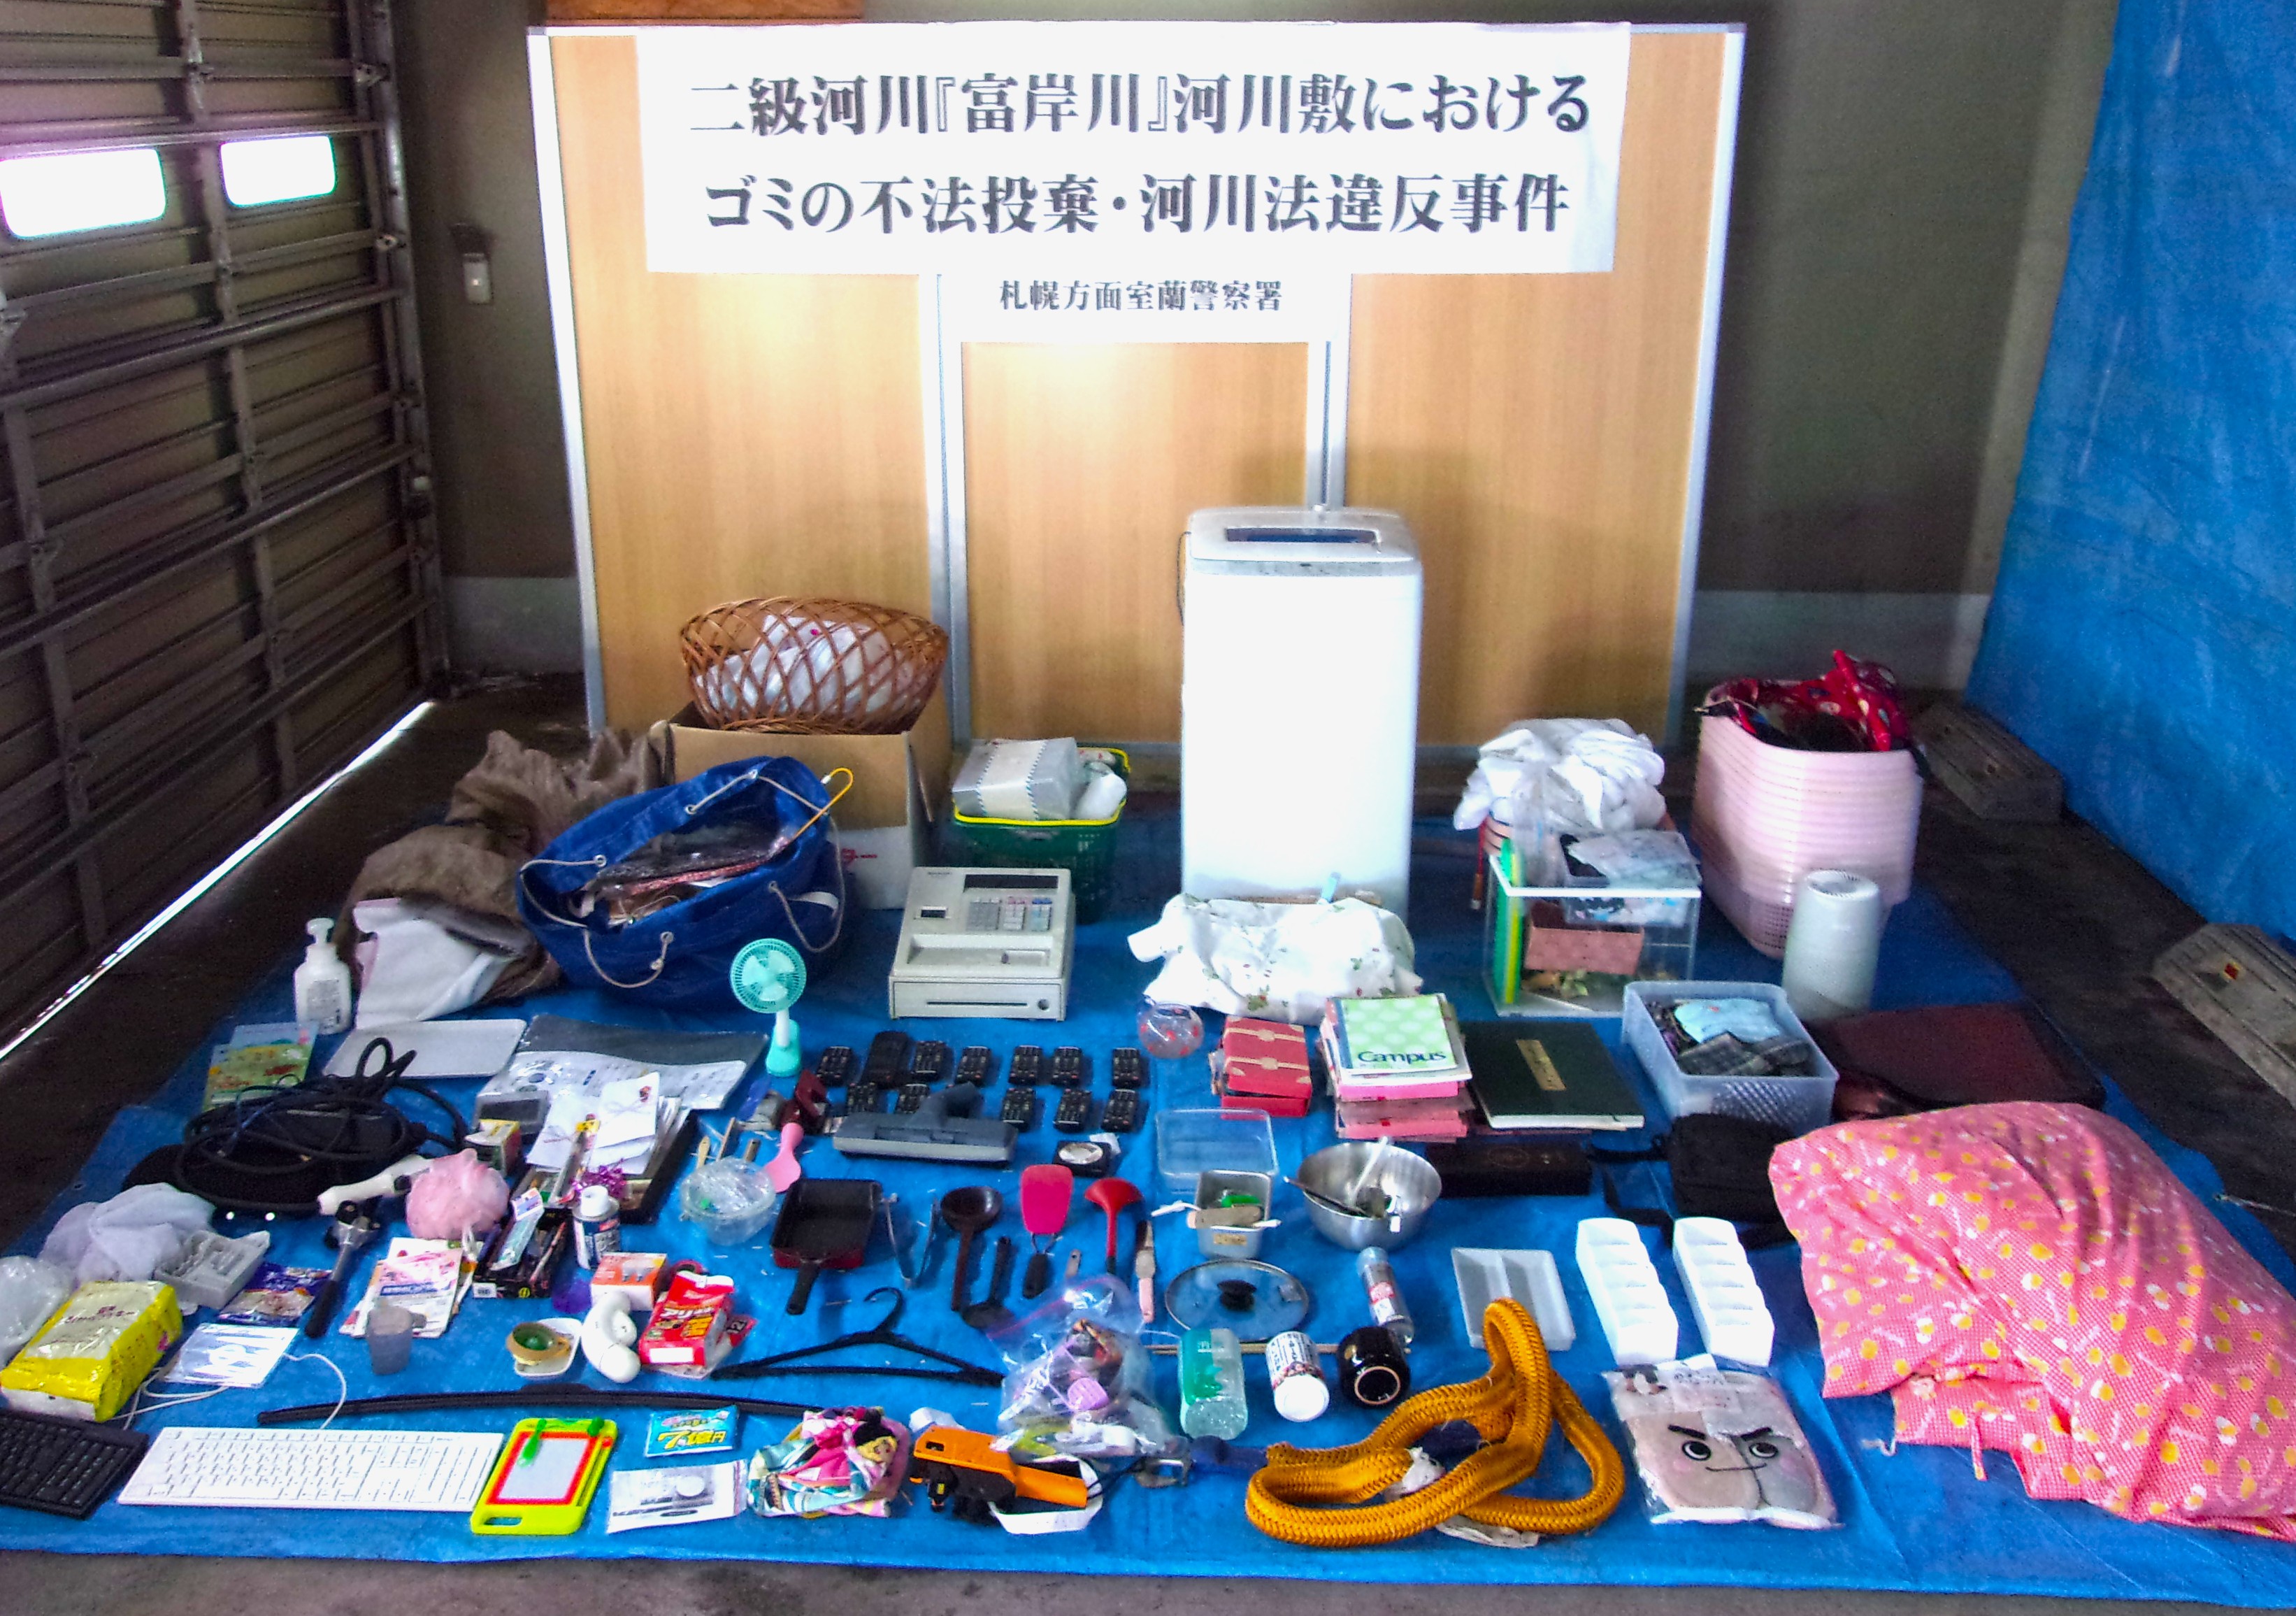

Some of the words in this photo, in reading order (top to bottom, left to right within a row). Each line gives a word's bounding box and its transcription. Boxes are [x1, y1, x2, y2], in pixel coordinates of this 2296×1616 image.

[690, 73, 1590, 137] 二級河川『富岸川』河川敷における
[705, 173, 1570, 235] ゴミの不法投棄・河川法違反事件
[1000, 280, 1281, 311] 札幌方面室蘭警察署
[1357, 1051, 1447, 1065] Campus
